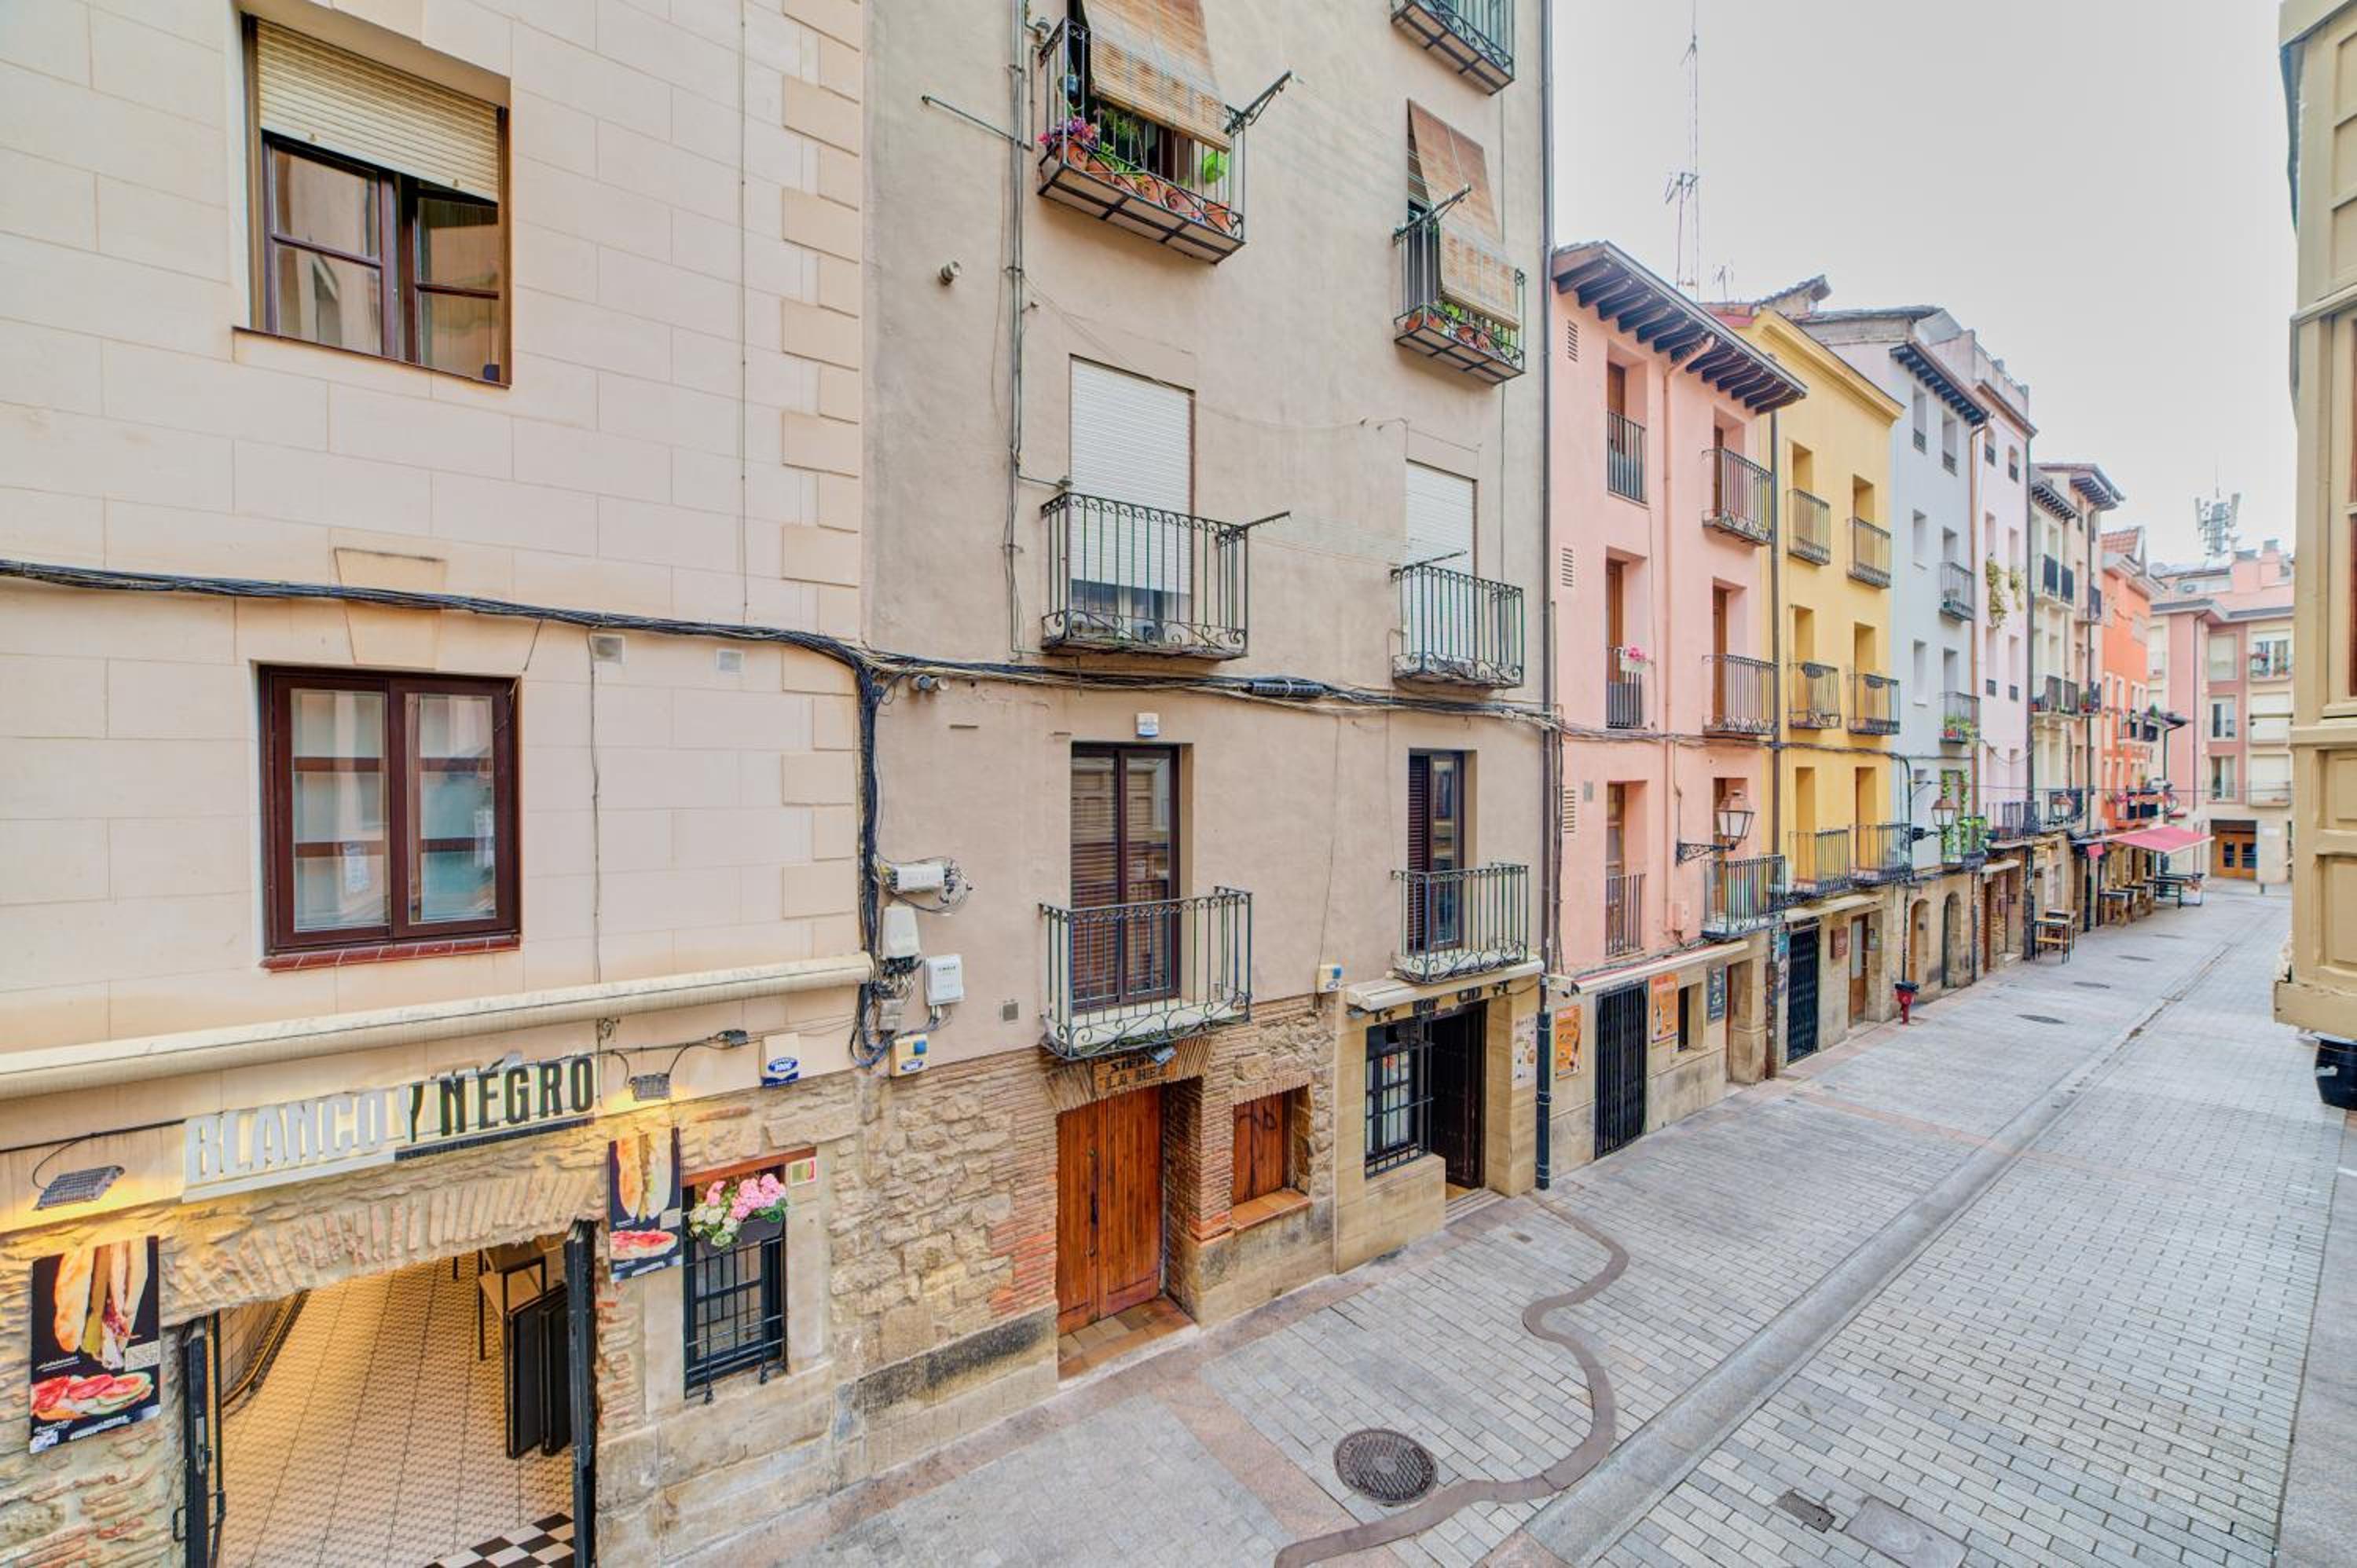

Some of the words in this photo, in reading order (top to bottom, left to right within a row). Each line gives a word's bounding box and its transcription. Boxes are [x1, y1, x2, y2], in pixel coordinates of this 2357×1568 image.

[185, 1090, 384, 1184] BLANCO
[398, 1082, 424, 1143] Y
[439, 1056, 595, 1137] NEGRO
